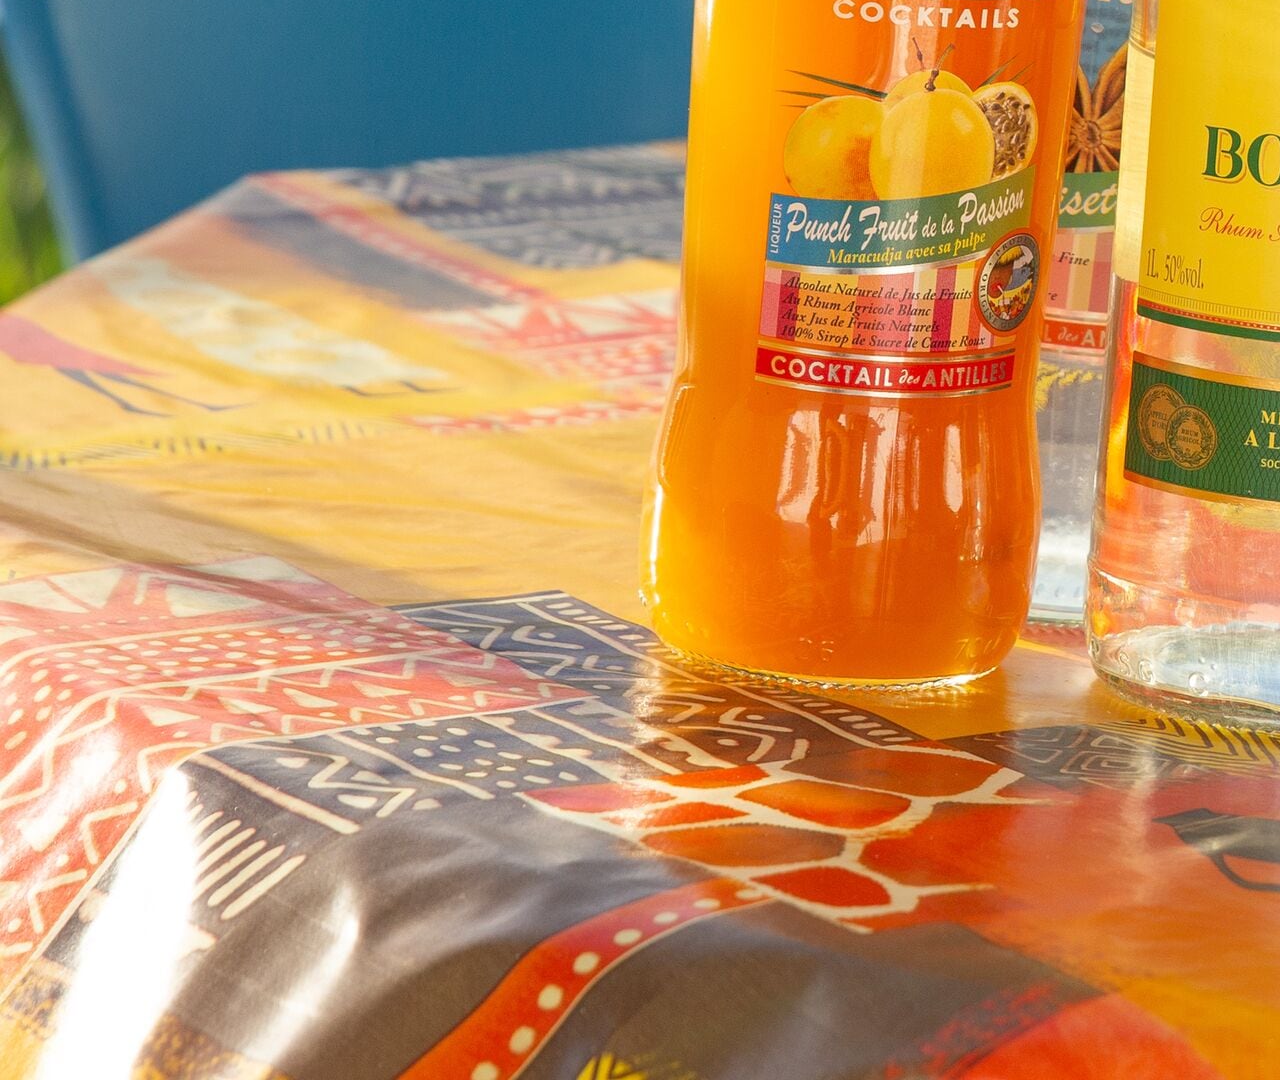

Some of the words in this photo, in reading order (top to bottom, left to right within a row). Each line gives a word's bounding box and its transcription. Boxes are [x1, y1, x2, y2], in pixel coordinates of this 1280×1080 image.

[770, 202, 784, 254] LIQUEUR
[785, 202, 852, 243] Punch
[858, 205, 918, 251] Fruit
[921, 221, 937, 238] de
[941, 217, 955, 235] la
[957, 188, 1025, 236] Passion
[1199, 206, 1265, 240] Rhum
[826, 247, 903, 265] Maracudja
[905, 246, 935, 261] avec
[937, 241, 951, 255] sa
[953, 231, 987, 256] pulpe
[1058, 251, 1091, 266] Fine
[784, 275, 832, 294] Alcoolat
[833, 283, 883, 299] Naturel
[885, 288, 899, 300] de
[900, 290, 920, 301] Jus
[923, 289, 937, 301] de
[938, 288, 973, 300] Fruits
[782, 291, 801, 304] Au
[802, 295, 841, 311] Rhum
[842, 300, 895, 318] Agricole
[898, 305, 932, 317] Blanc
[781, 308, 807, 323] Aux
[808, 312, 828, 326] Jus
[830, 316, 845, 328] de
[847, 317, 886, 331] Fruits
[889, 319, 941, 333] Naturels
[780, 324, 814, 339] 100%
[816, 330, 849, 348] Sirop
[851, 333, 866, 346] de
[869, 336, 902, 348] Sucre
[904, 336, 918, 348] de
[921, 336, 958, 349] Canne
[959, 335, 986, 347] Roux
[770, 354, 894, 388] COCKTAIL
[899, 369, 921, 384] des
[922, 361, 1007, 388] ANTILLES
[1244, 429, 1260, 447] A
